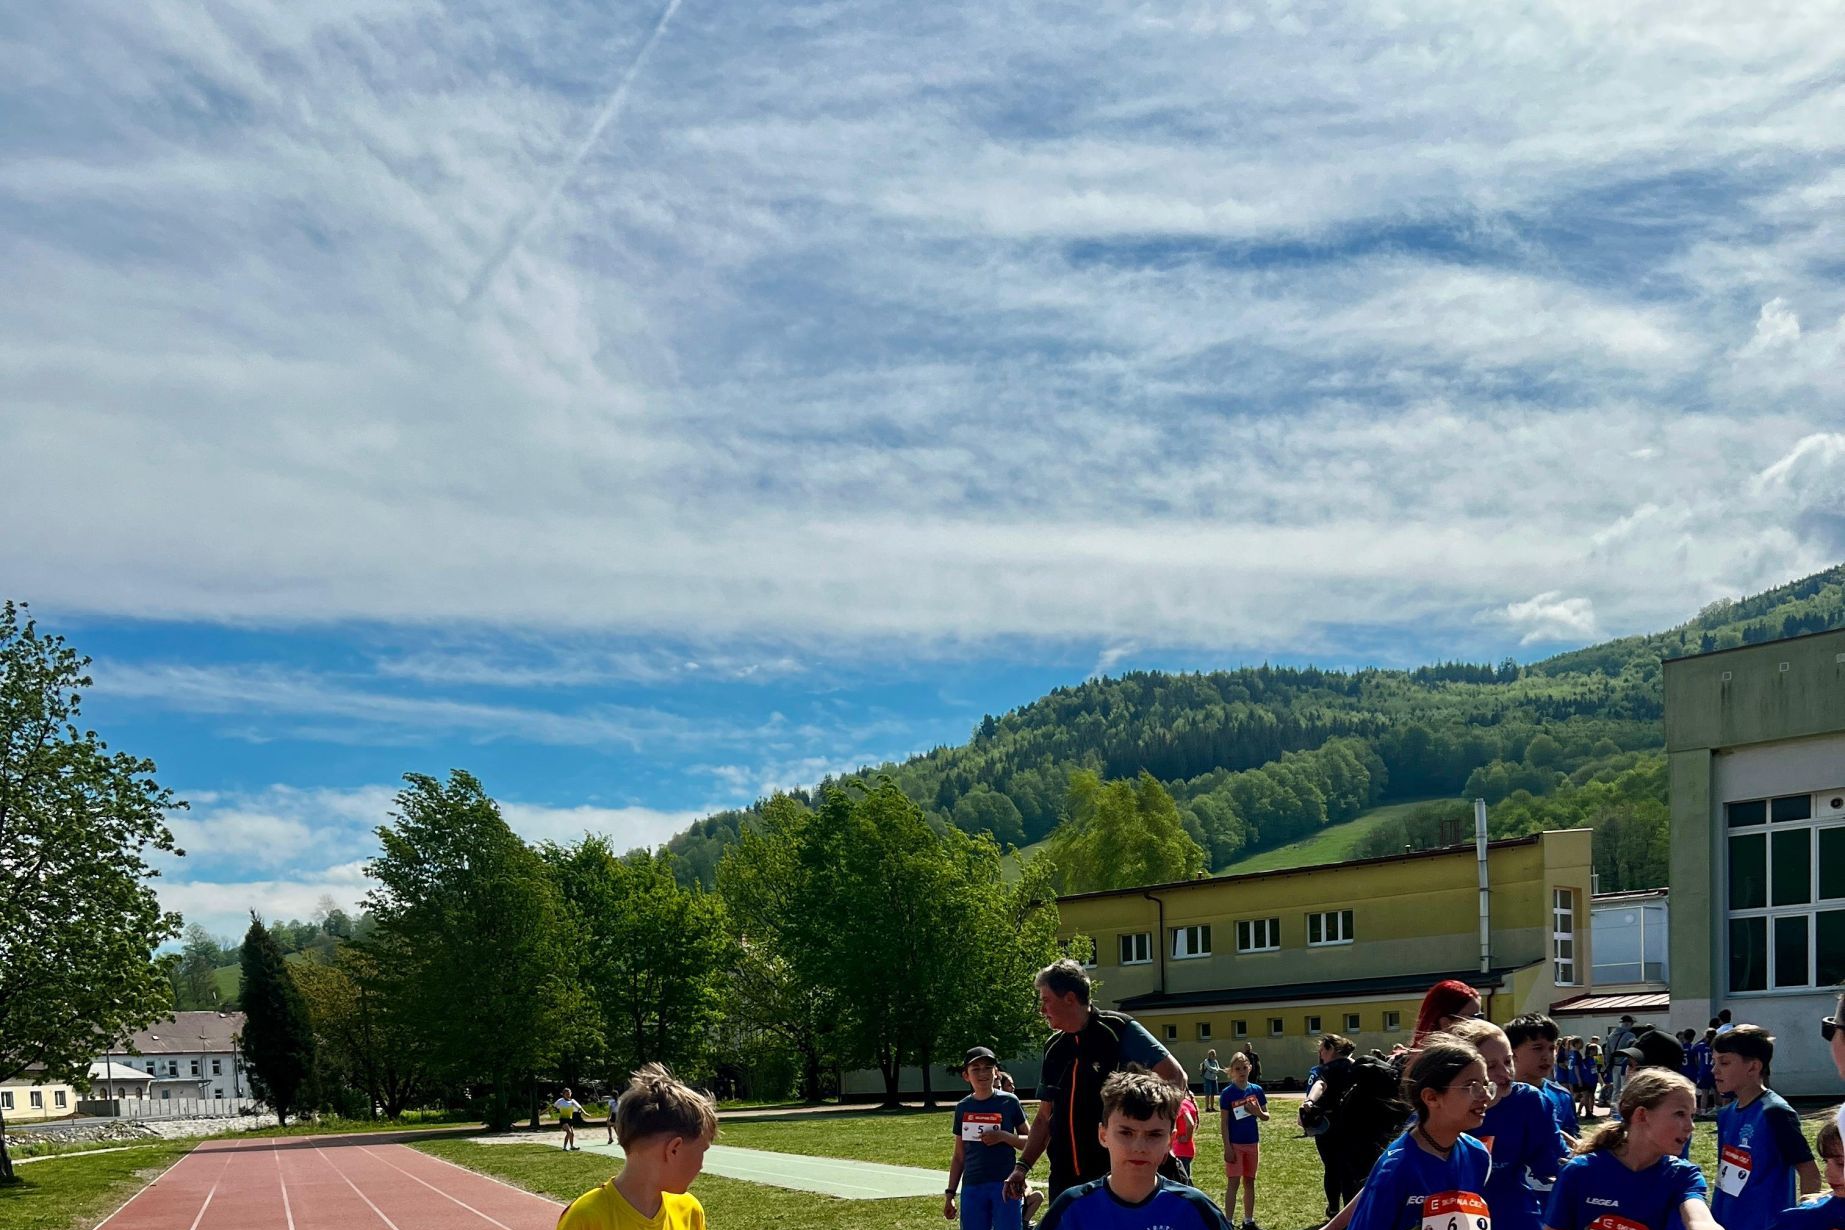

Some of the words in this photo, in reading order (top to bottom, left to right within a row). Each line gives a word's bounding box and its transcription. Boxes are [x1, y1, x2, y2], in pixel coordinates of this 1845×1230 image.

[977, 1125, 984, 1134] 5
[1406, 1195, 1427, 1206] EG
[1585, 1196, 1619, 1207] LEGEA
